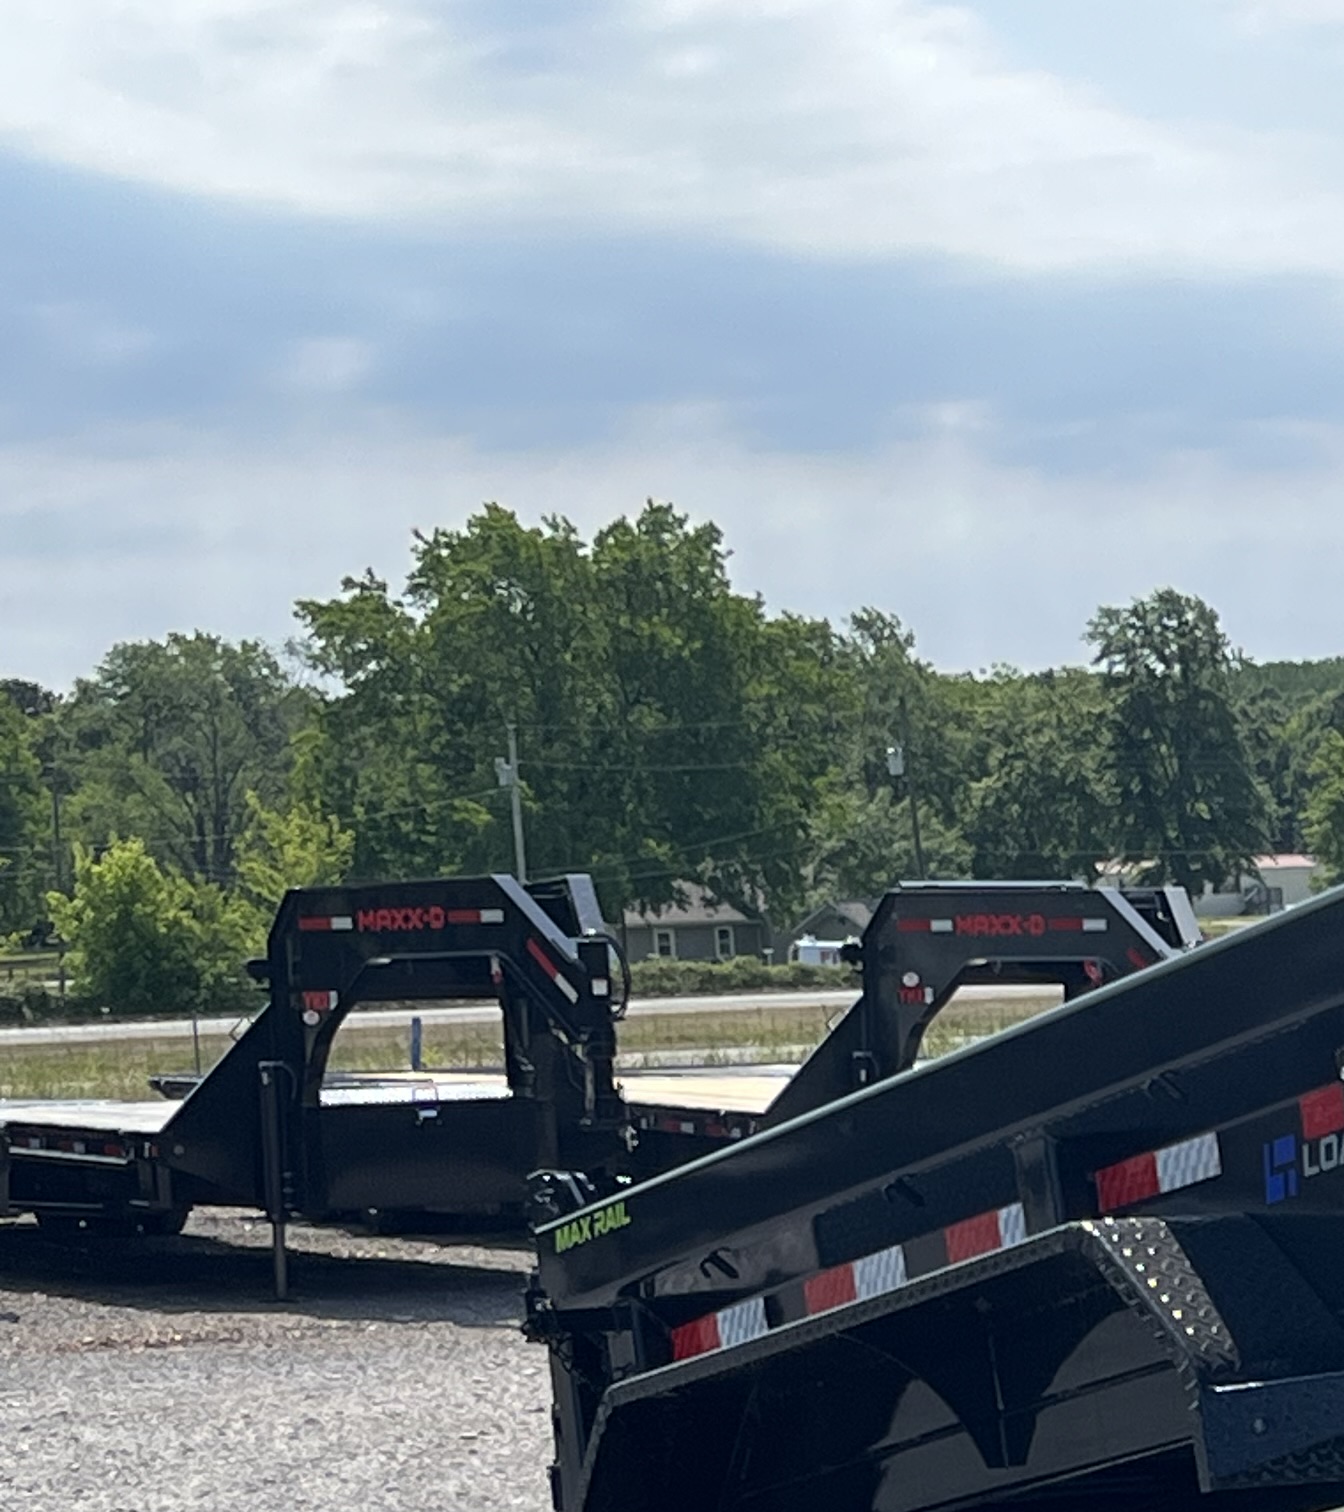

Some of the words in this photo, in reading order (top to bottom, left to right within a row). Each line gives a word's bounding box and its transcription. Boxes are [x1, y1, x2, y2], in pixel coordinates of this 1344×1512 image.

[356, 905, 446, 932] MAXX-D
[954, 913, 1046, 936] MAXX-D
[555, 1216, 592, 1254] MAX
[593, 1200, 631, 1238] RAIL
